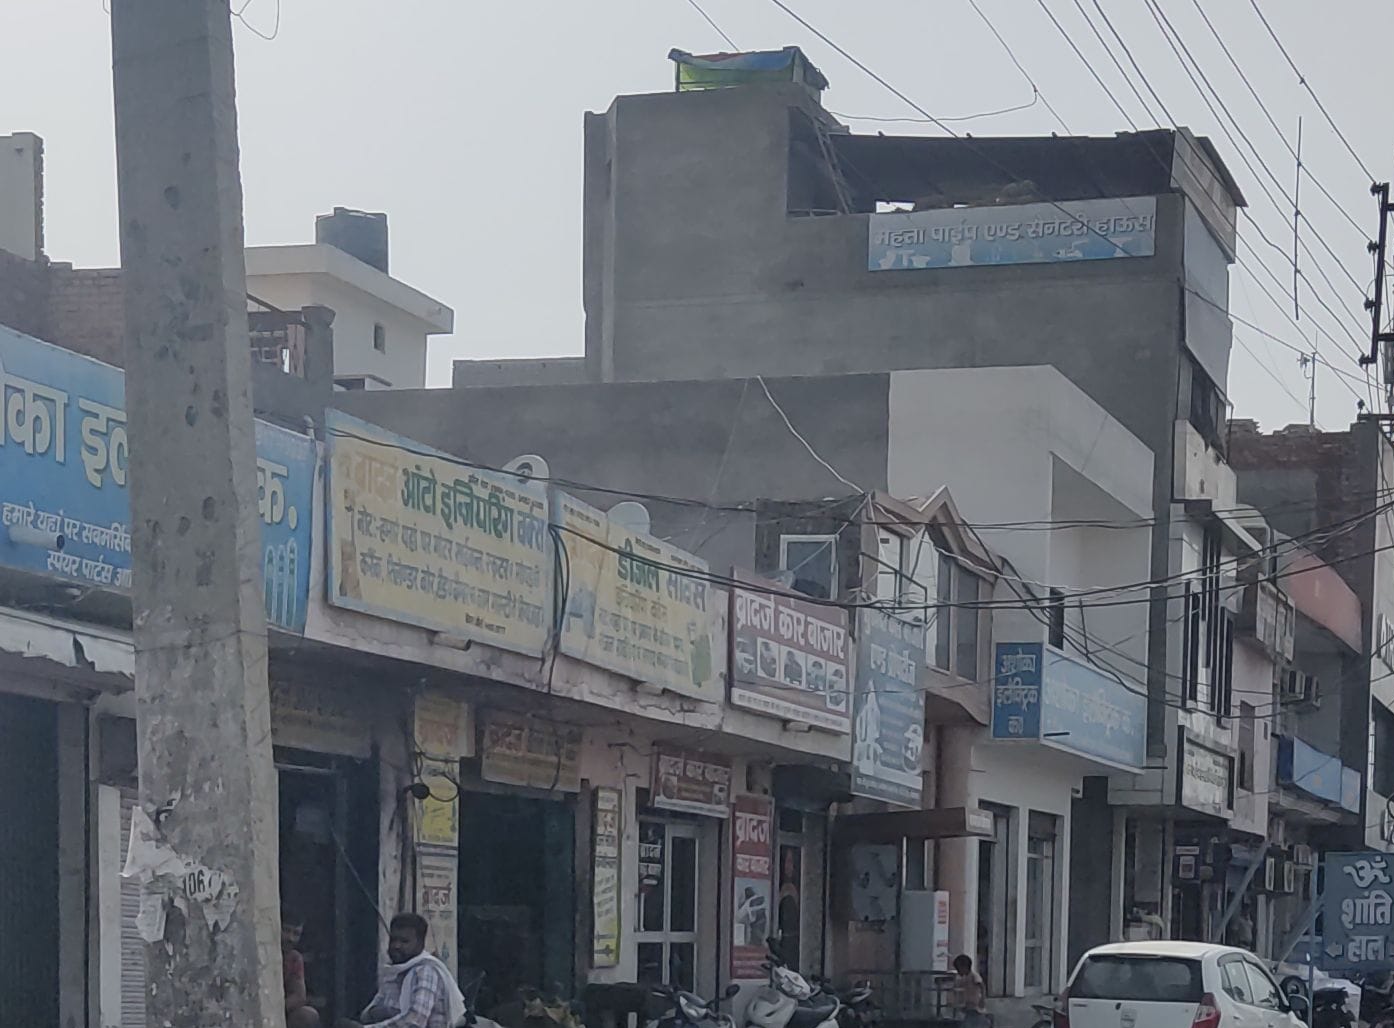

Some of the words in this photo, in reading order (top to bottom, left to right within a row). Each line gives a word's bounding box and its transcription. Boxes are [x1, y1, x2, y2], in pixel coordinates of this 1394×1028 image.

[64, 520, 80, 542] पर
[778, 604, 806, 646] कार
[1341, 889, 1393, 929] शांति
[1347, 935, 1385, 962] हाल
